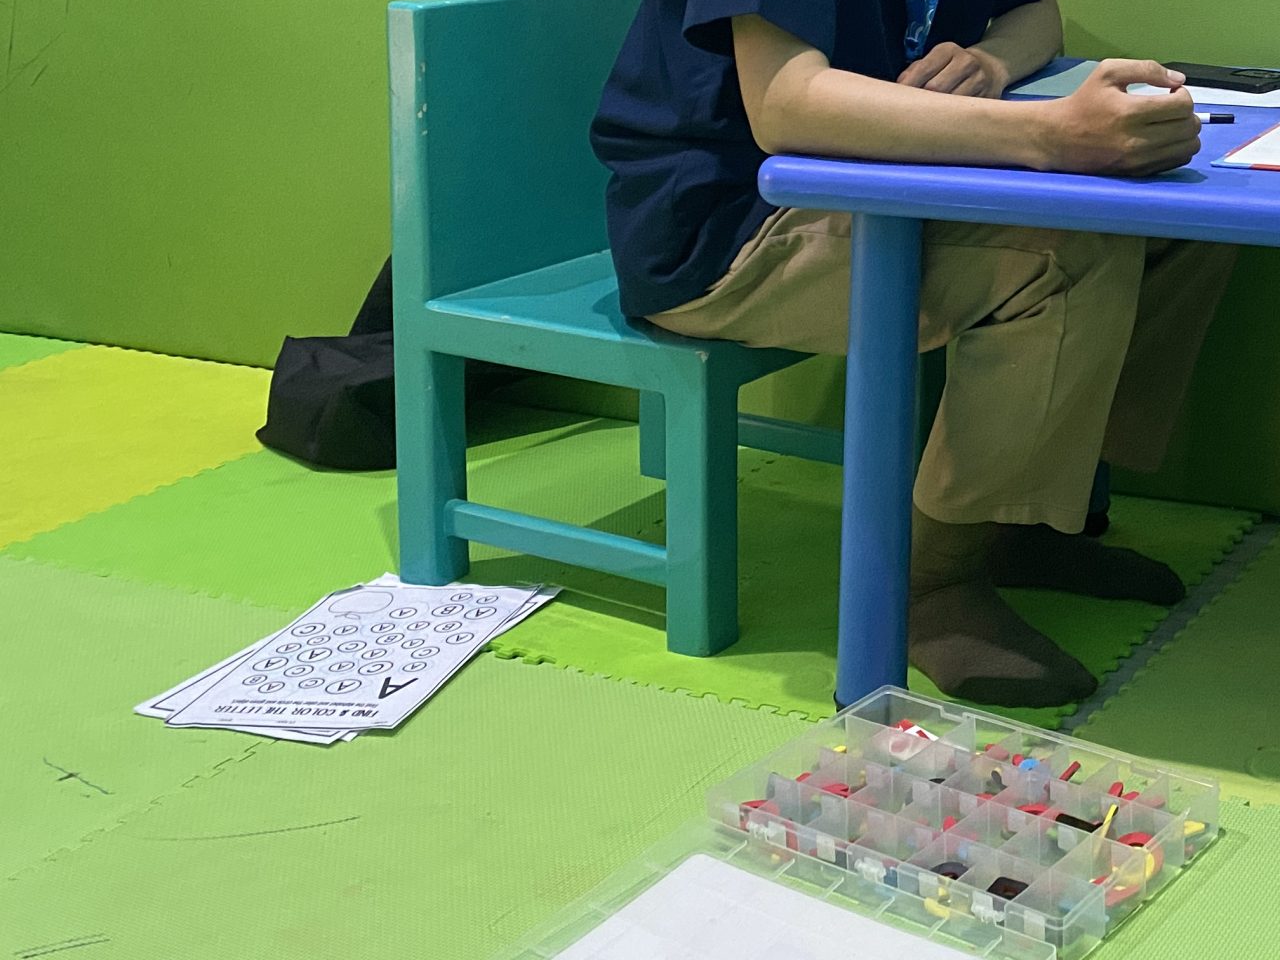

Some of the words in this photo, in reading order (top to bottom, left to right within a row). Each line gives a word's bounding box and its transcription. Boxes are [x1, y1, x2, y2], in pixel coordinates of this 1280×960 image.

[378, 676, 419, 699] A
[214, 705, 264, 714] LETTER
[263, 706, 287, 715] THE
[291, 707, 337, 716] COLOR
[351, 709, 379, 718] FIND
